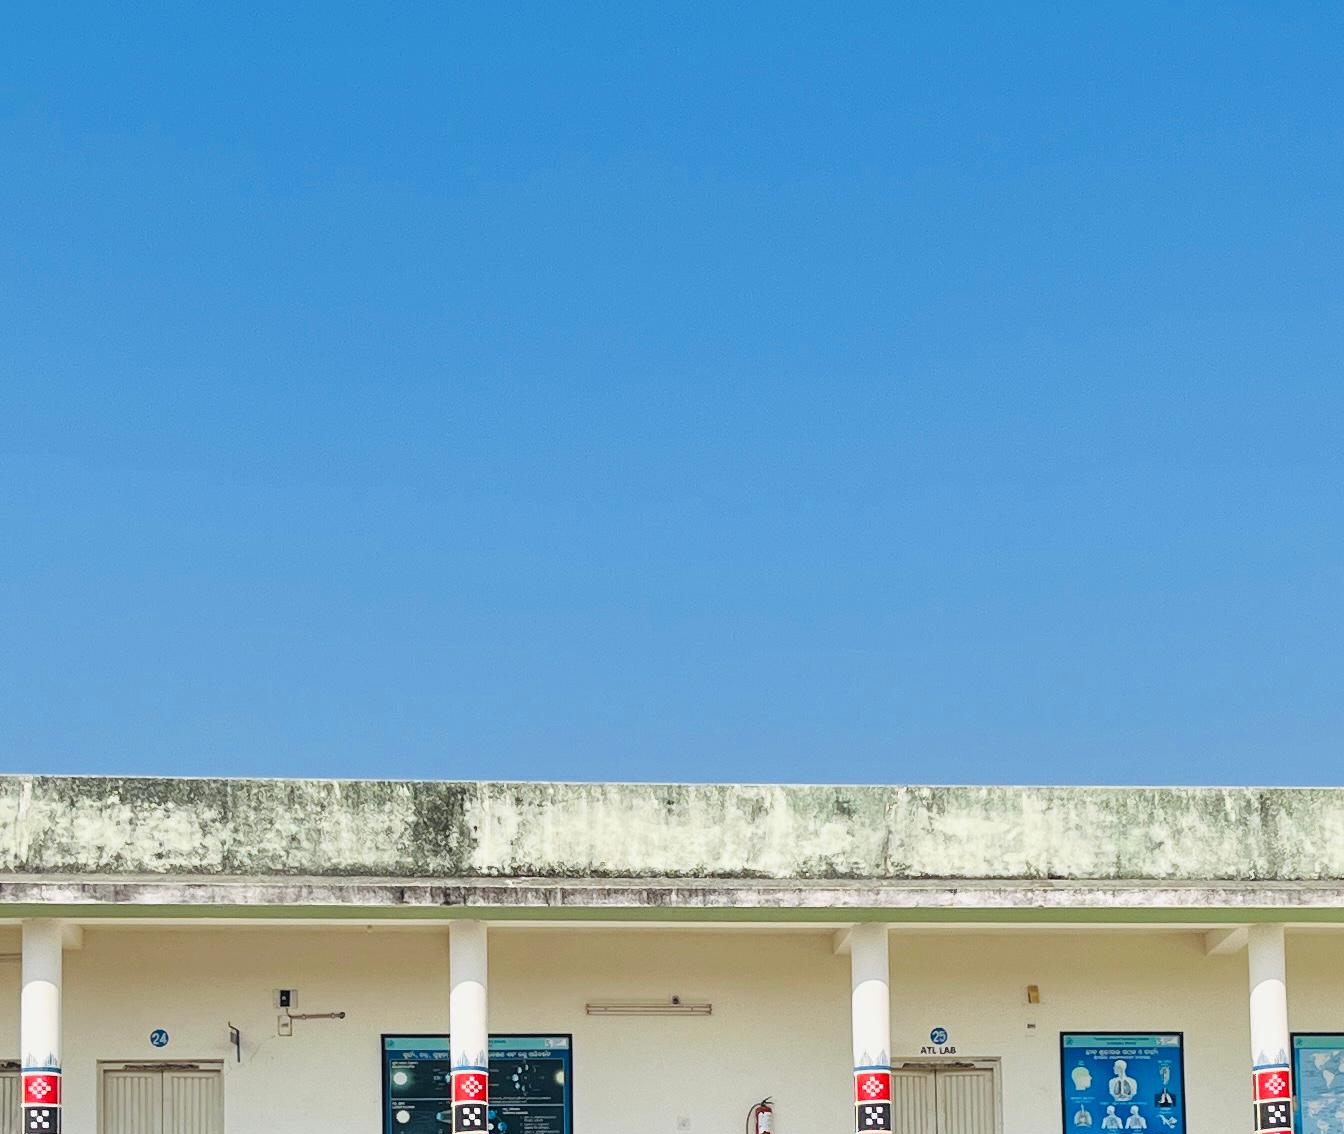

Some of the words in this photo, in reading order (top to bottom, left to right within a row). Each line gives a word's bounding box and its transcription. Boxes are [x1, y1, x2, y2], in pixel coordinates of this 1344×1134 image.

[152, 1031, 168, 1045] 24
[932, 1030, 947, 1042] 25
[920, 1046, 937, 1054] ATL
[939, 1046, 957, 1054] LAB
